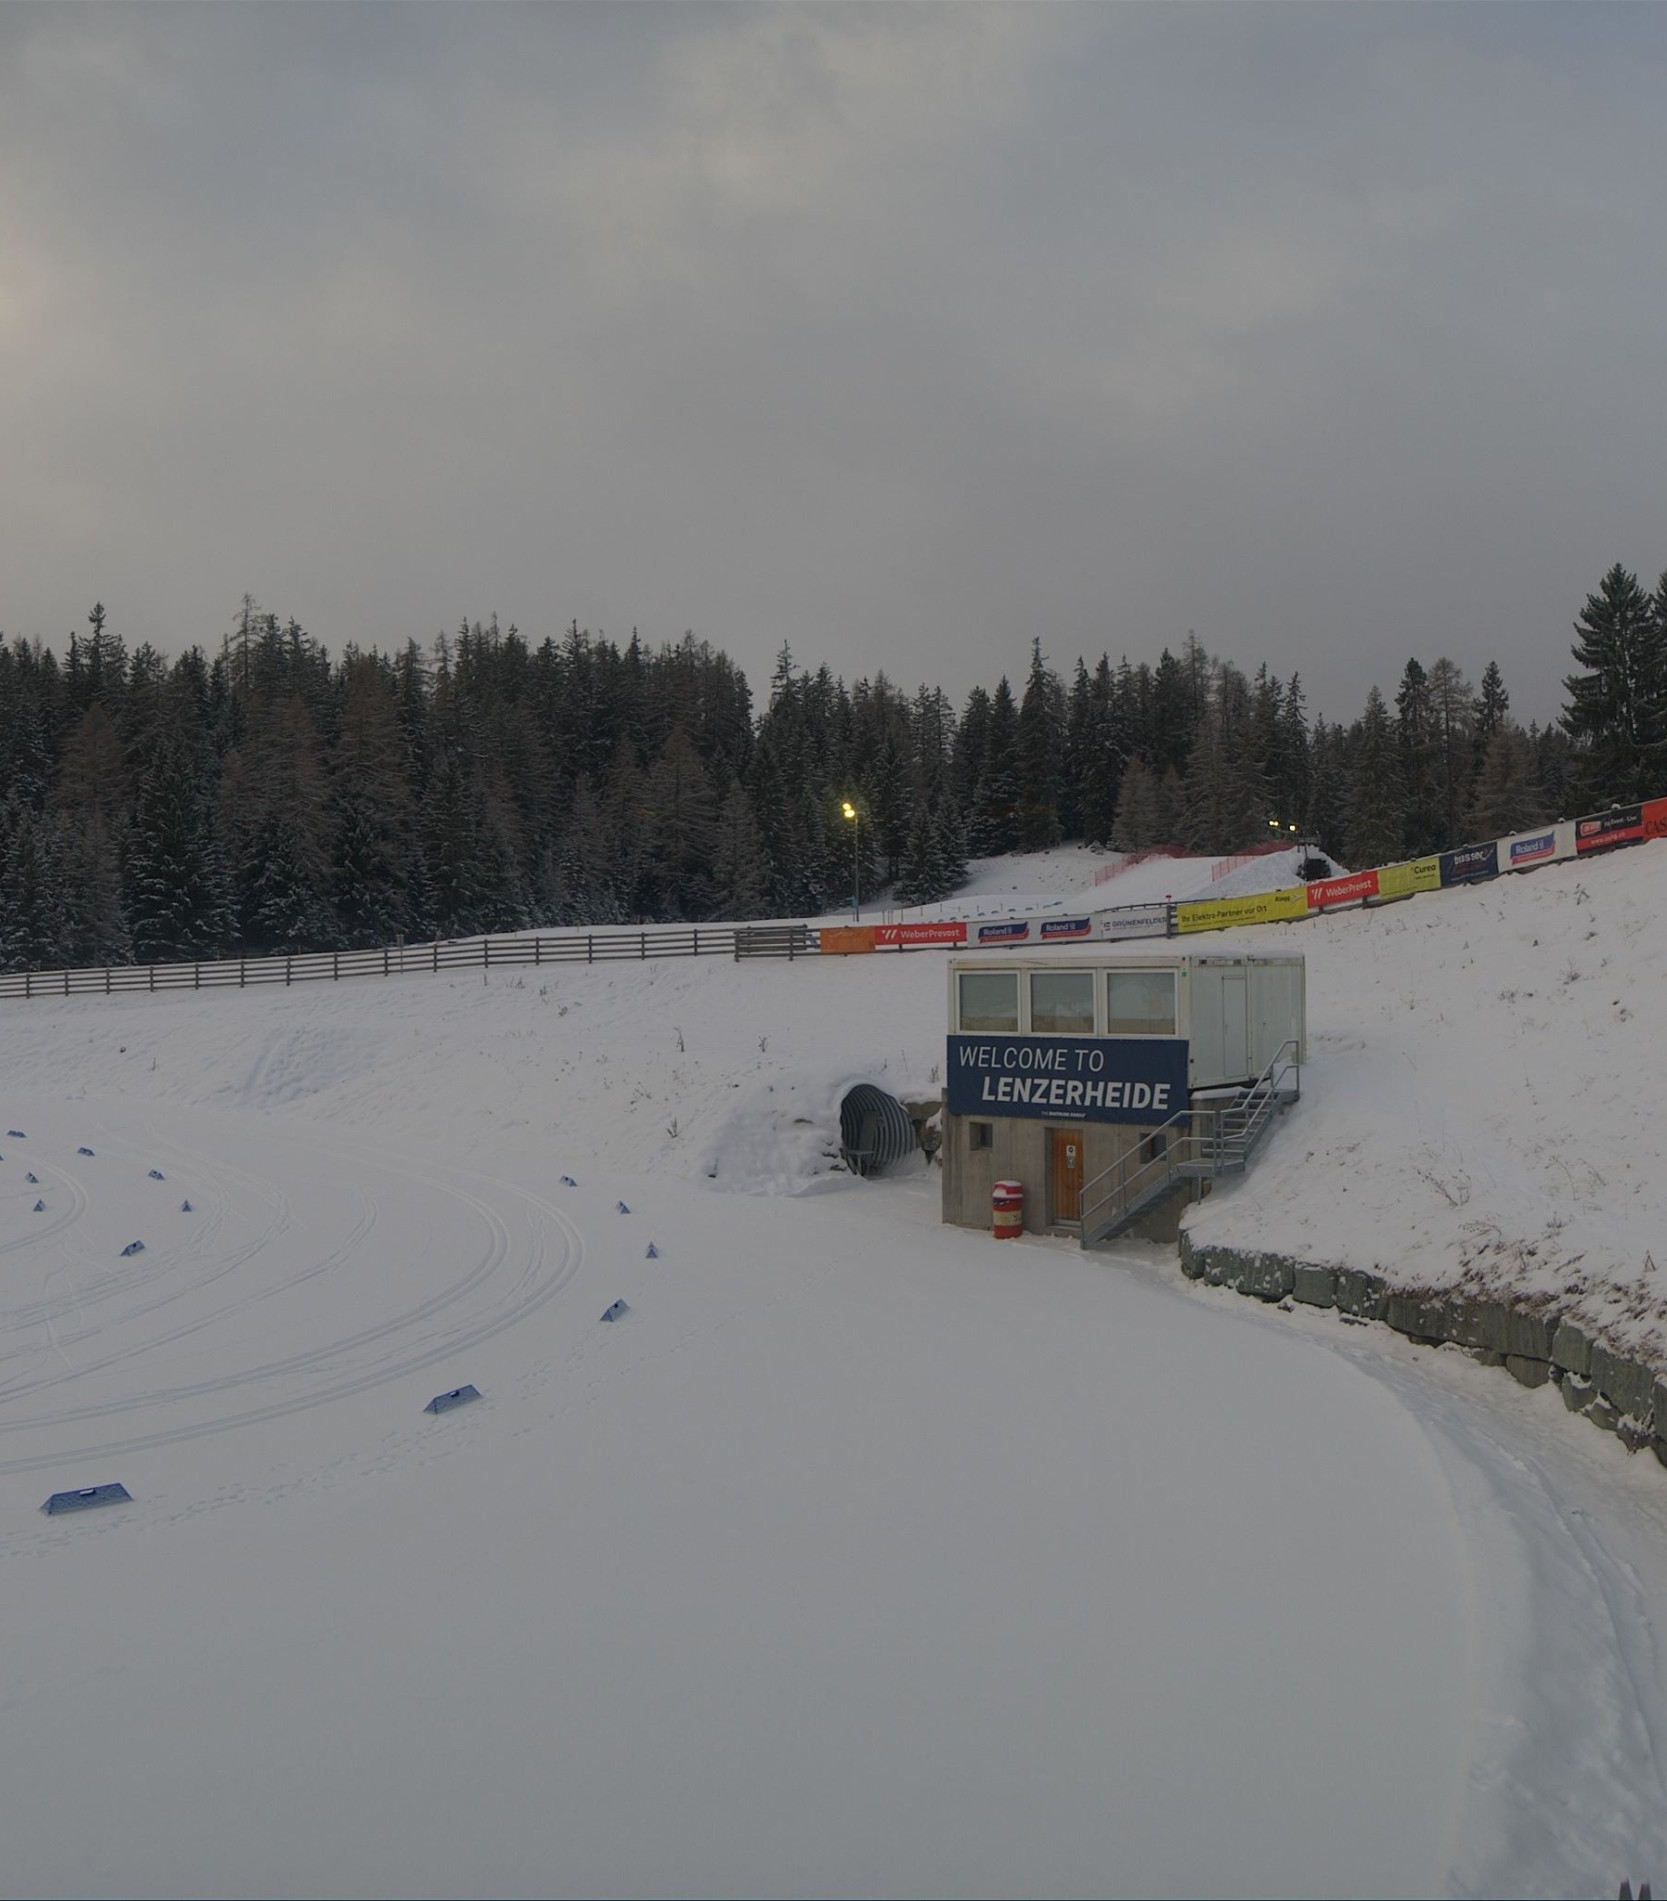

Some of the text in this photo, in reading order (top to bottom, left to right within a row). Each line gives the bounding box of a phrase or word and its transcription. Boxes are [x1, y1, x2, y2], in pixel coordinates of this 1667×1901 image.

[1515, 843, 1538, 854] Roland
[1192, 909, 1243, 921] Elektro-Partner
[1256, 905, 1267, 913] Ort
[983, 927, 1008, 936] Roland
[1045, 922, 1069, 932] Roland
[900, 928, 960, 939] WeberPrevost
[959, 1045, 1105, 1073] WELCOME TO
[981, 1076, 1171, 1110] LENZERHEIDE
